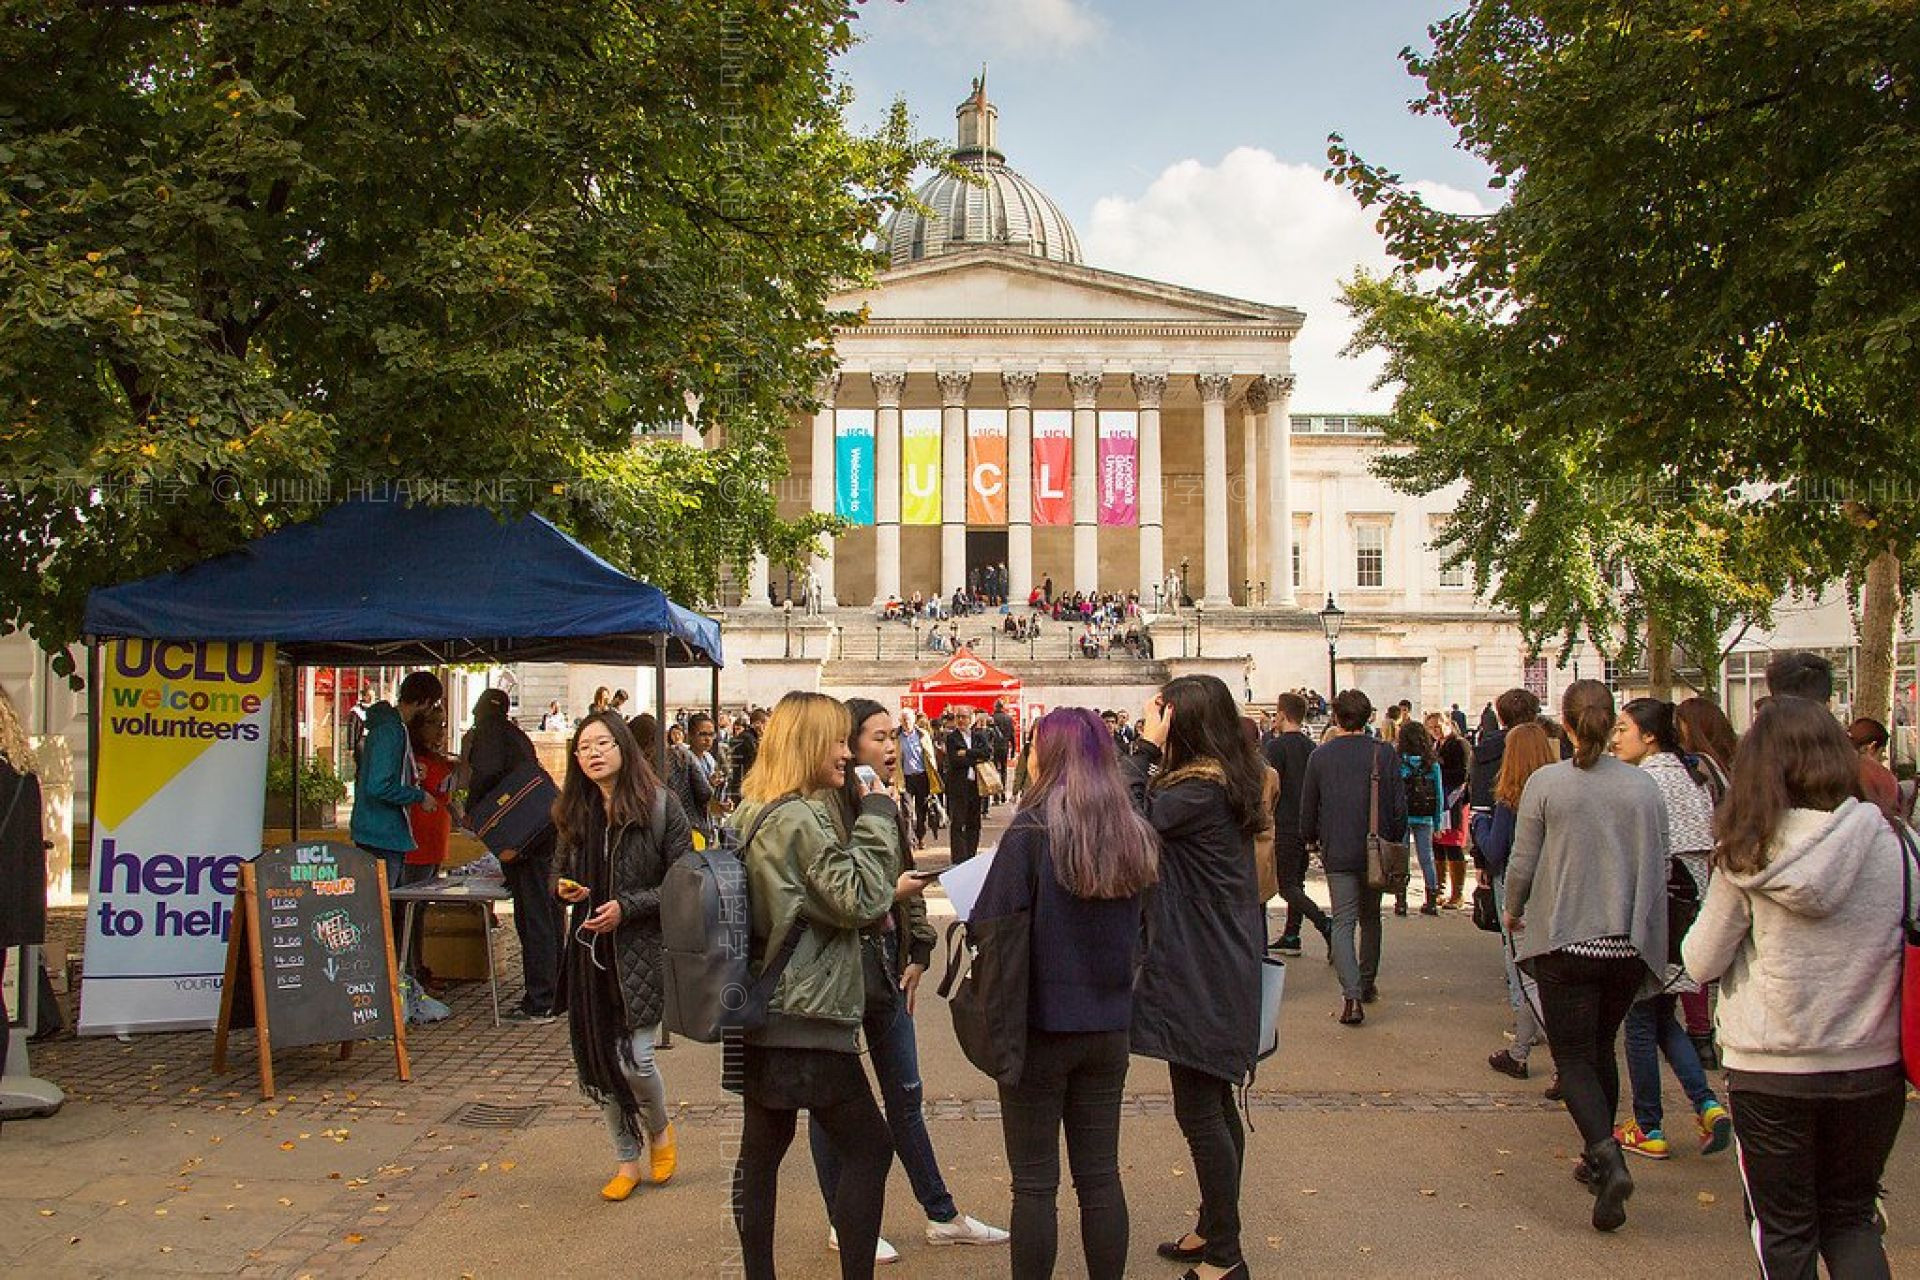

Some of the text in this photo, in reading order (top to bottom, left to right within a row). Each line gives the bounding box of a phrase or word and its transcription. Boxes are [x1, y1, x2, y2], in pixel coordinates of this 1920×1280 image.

[850, 448, 861, 498] Welcome
[909, 464, 936, 497] U
[972, 463, 1003, 497] C
[1040, 464, 1064, 498] L
[115, 639, 265, 684] UCLU
[112, 683, 262, 713] welcome
[111, 713, 260, 742] volunteers
[99, 838, 243, 896] here
[297, 845, 335, 863] UCL
[290, 863, 339, 881] UNION
[98, 901, 144, 937] to
[346, 982, 376, 995] ONLY
[352, 1008, 379, 1025] MIN
